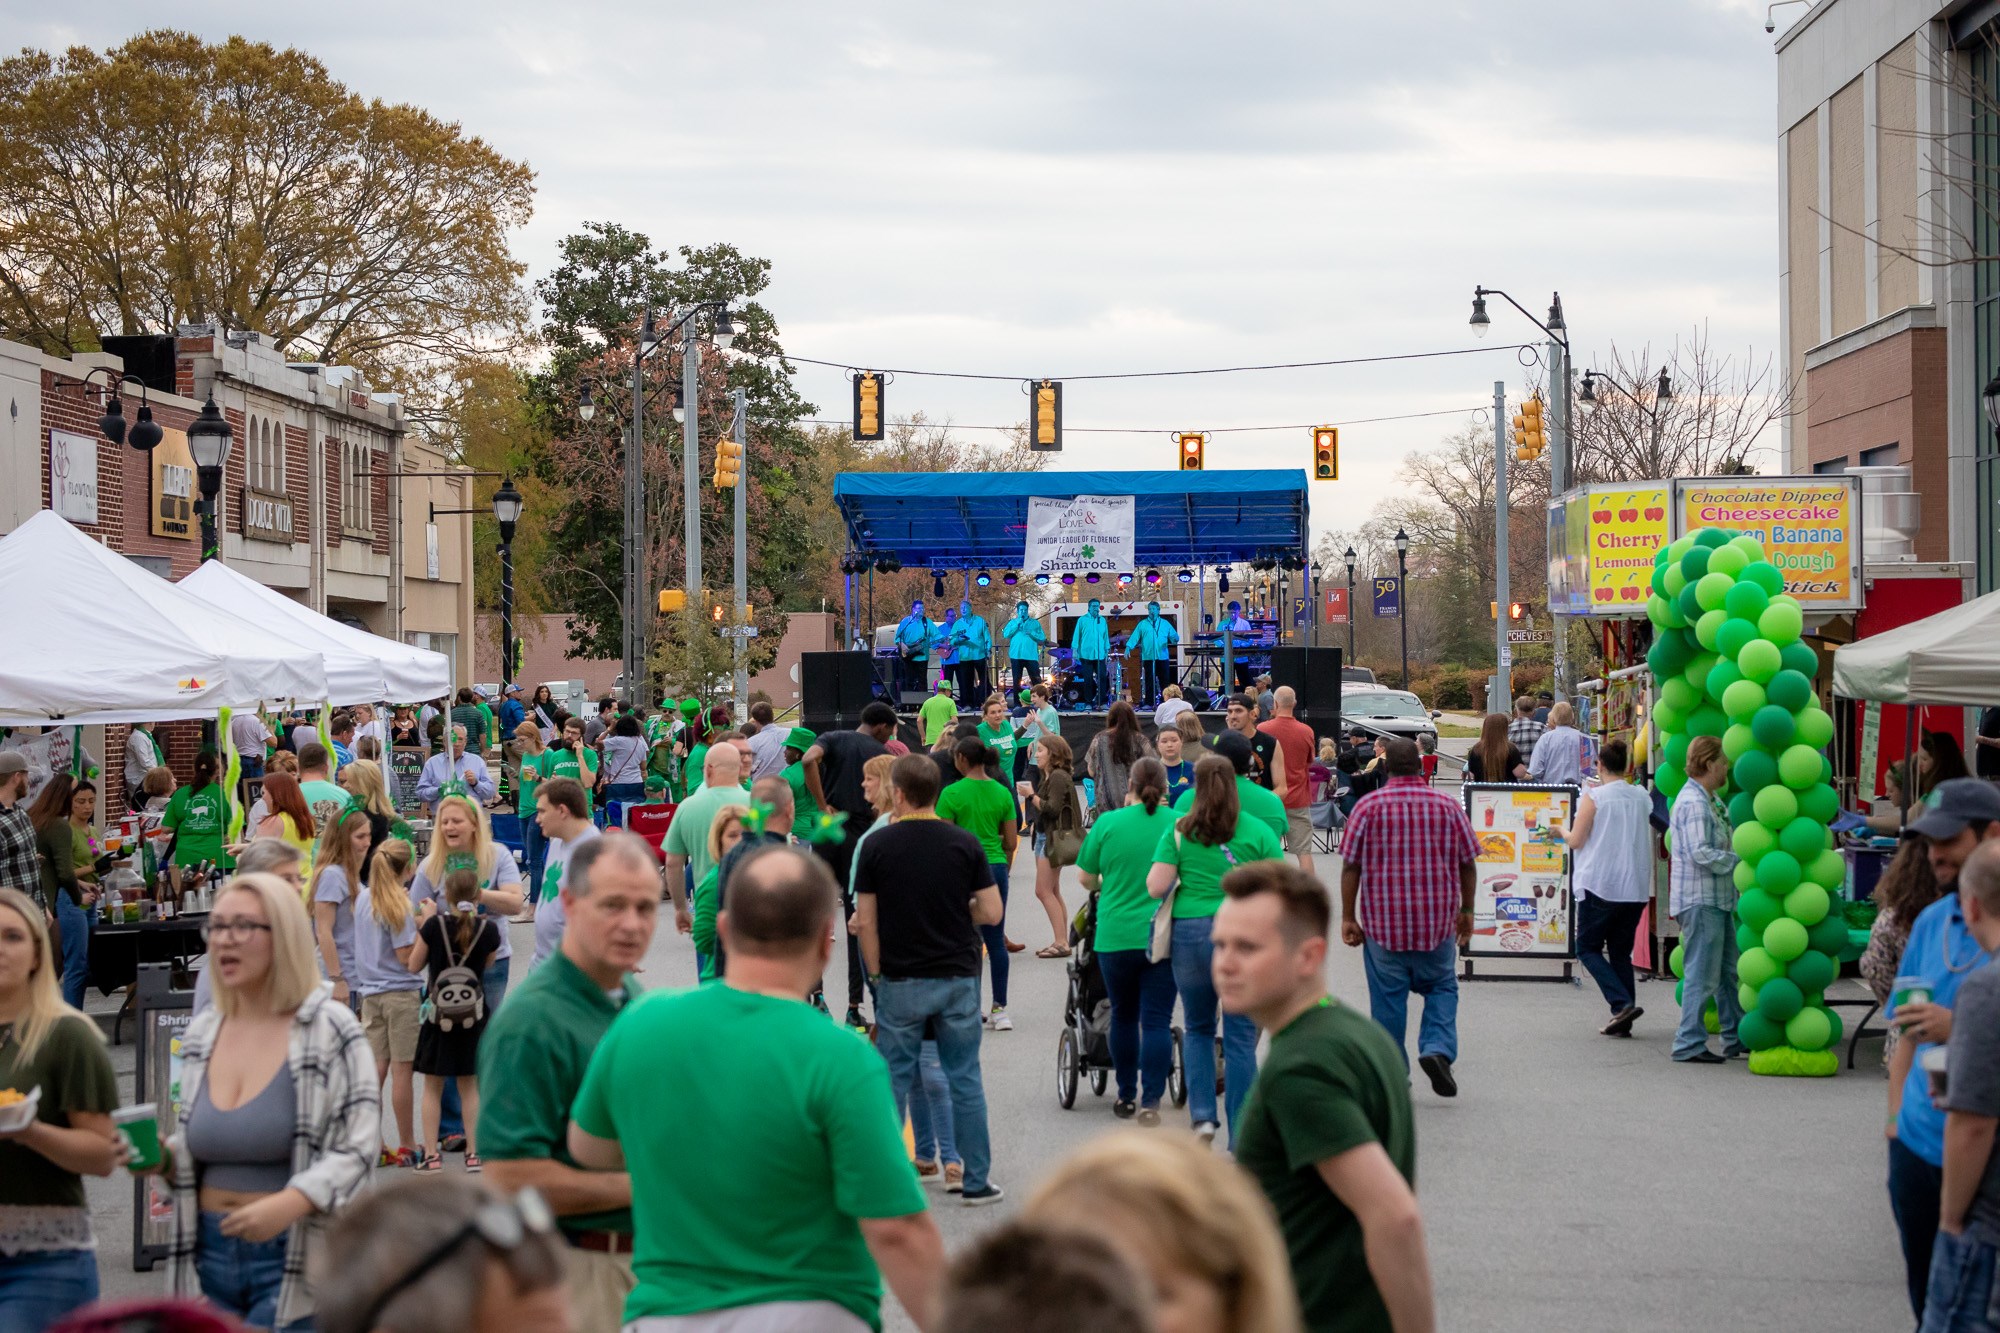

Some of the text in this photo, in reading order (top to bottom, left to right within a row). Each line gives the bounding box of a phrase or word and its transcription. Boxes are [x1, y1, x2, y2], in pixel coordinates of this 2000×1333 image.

[1691, 490, 1845, 504] Chocolate Dipped
[248, 498, 292, 533] DOLCE VITA
[1084, 510, 1097, 525] &
[1700, 505, 1840, 521] Cheesecake
[1059, 518, 1083, 528] LOVE
[1037, 535, 1121, 545] JUNIOR LEAGUE OF FLORENCE
[1597, 532, 1662, 549] Cherry
[1772, 526, 1843, 543] Banana
[1056, 545, 1080, 561] Lucky
[1040, 559, 1117, 571] Shamrock
[1595, 554, 1657, 569] Lemonad
[1773, 551, 1835, 573] Dough
[1375, 579, 1396, 599] 50
[1511, 631, 1543, 641] CHEVES
[393, 765, 421, 774] OLCE VITA
[1507, 904, 1533, 914] OREO
